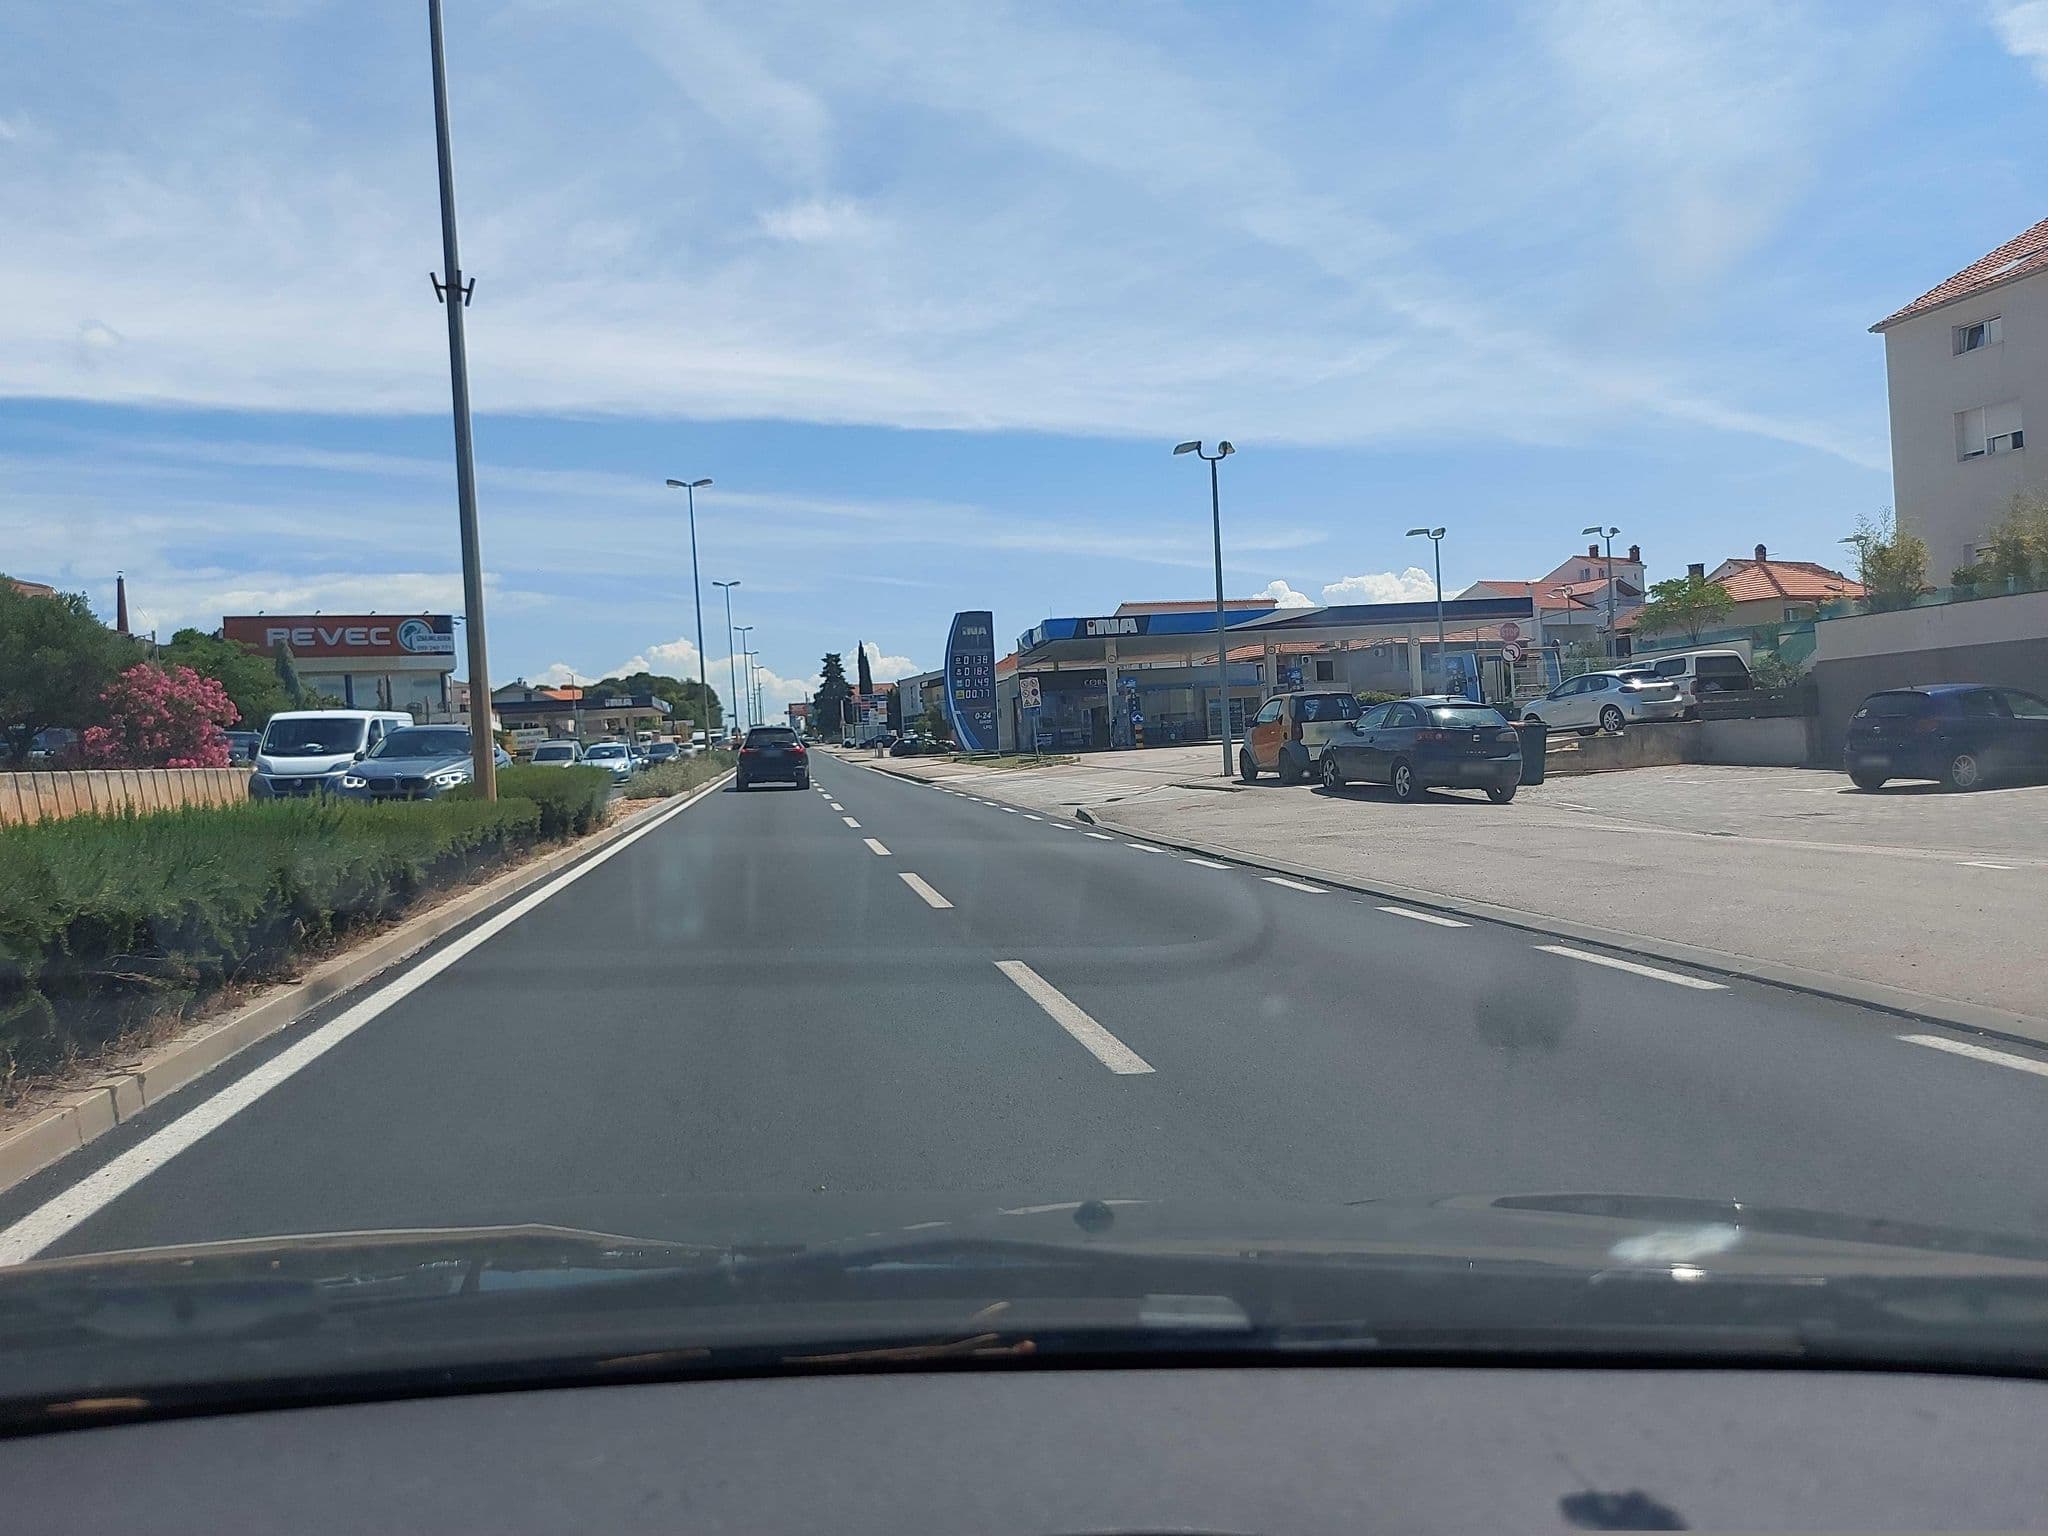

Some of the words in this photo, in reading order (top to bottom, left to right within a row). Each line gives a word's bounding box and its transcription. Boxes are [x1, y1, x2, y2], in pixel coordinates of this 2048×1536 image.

[266, 627, 391, 645] REVEC
[1501, 627, 1519, 637] STOP
[974, 711, 991, 720] 0-24
